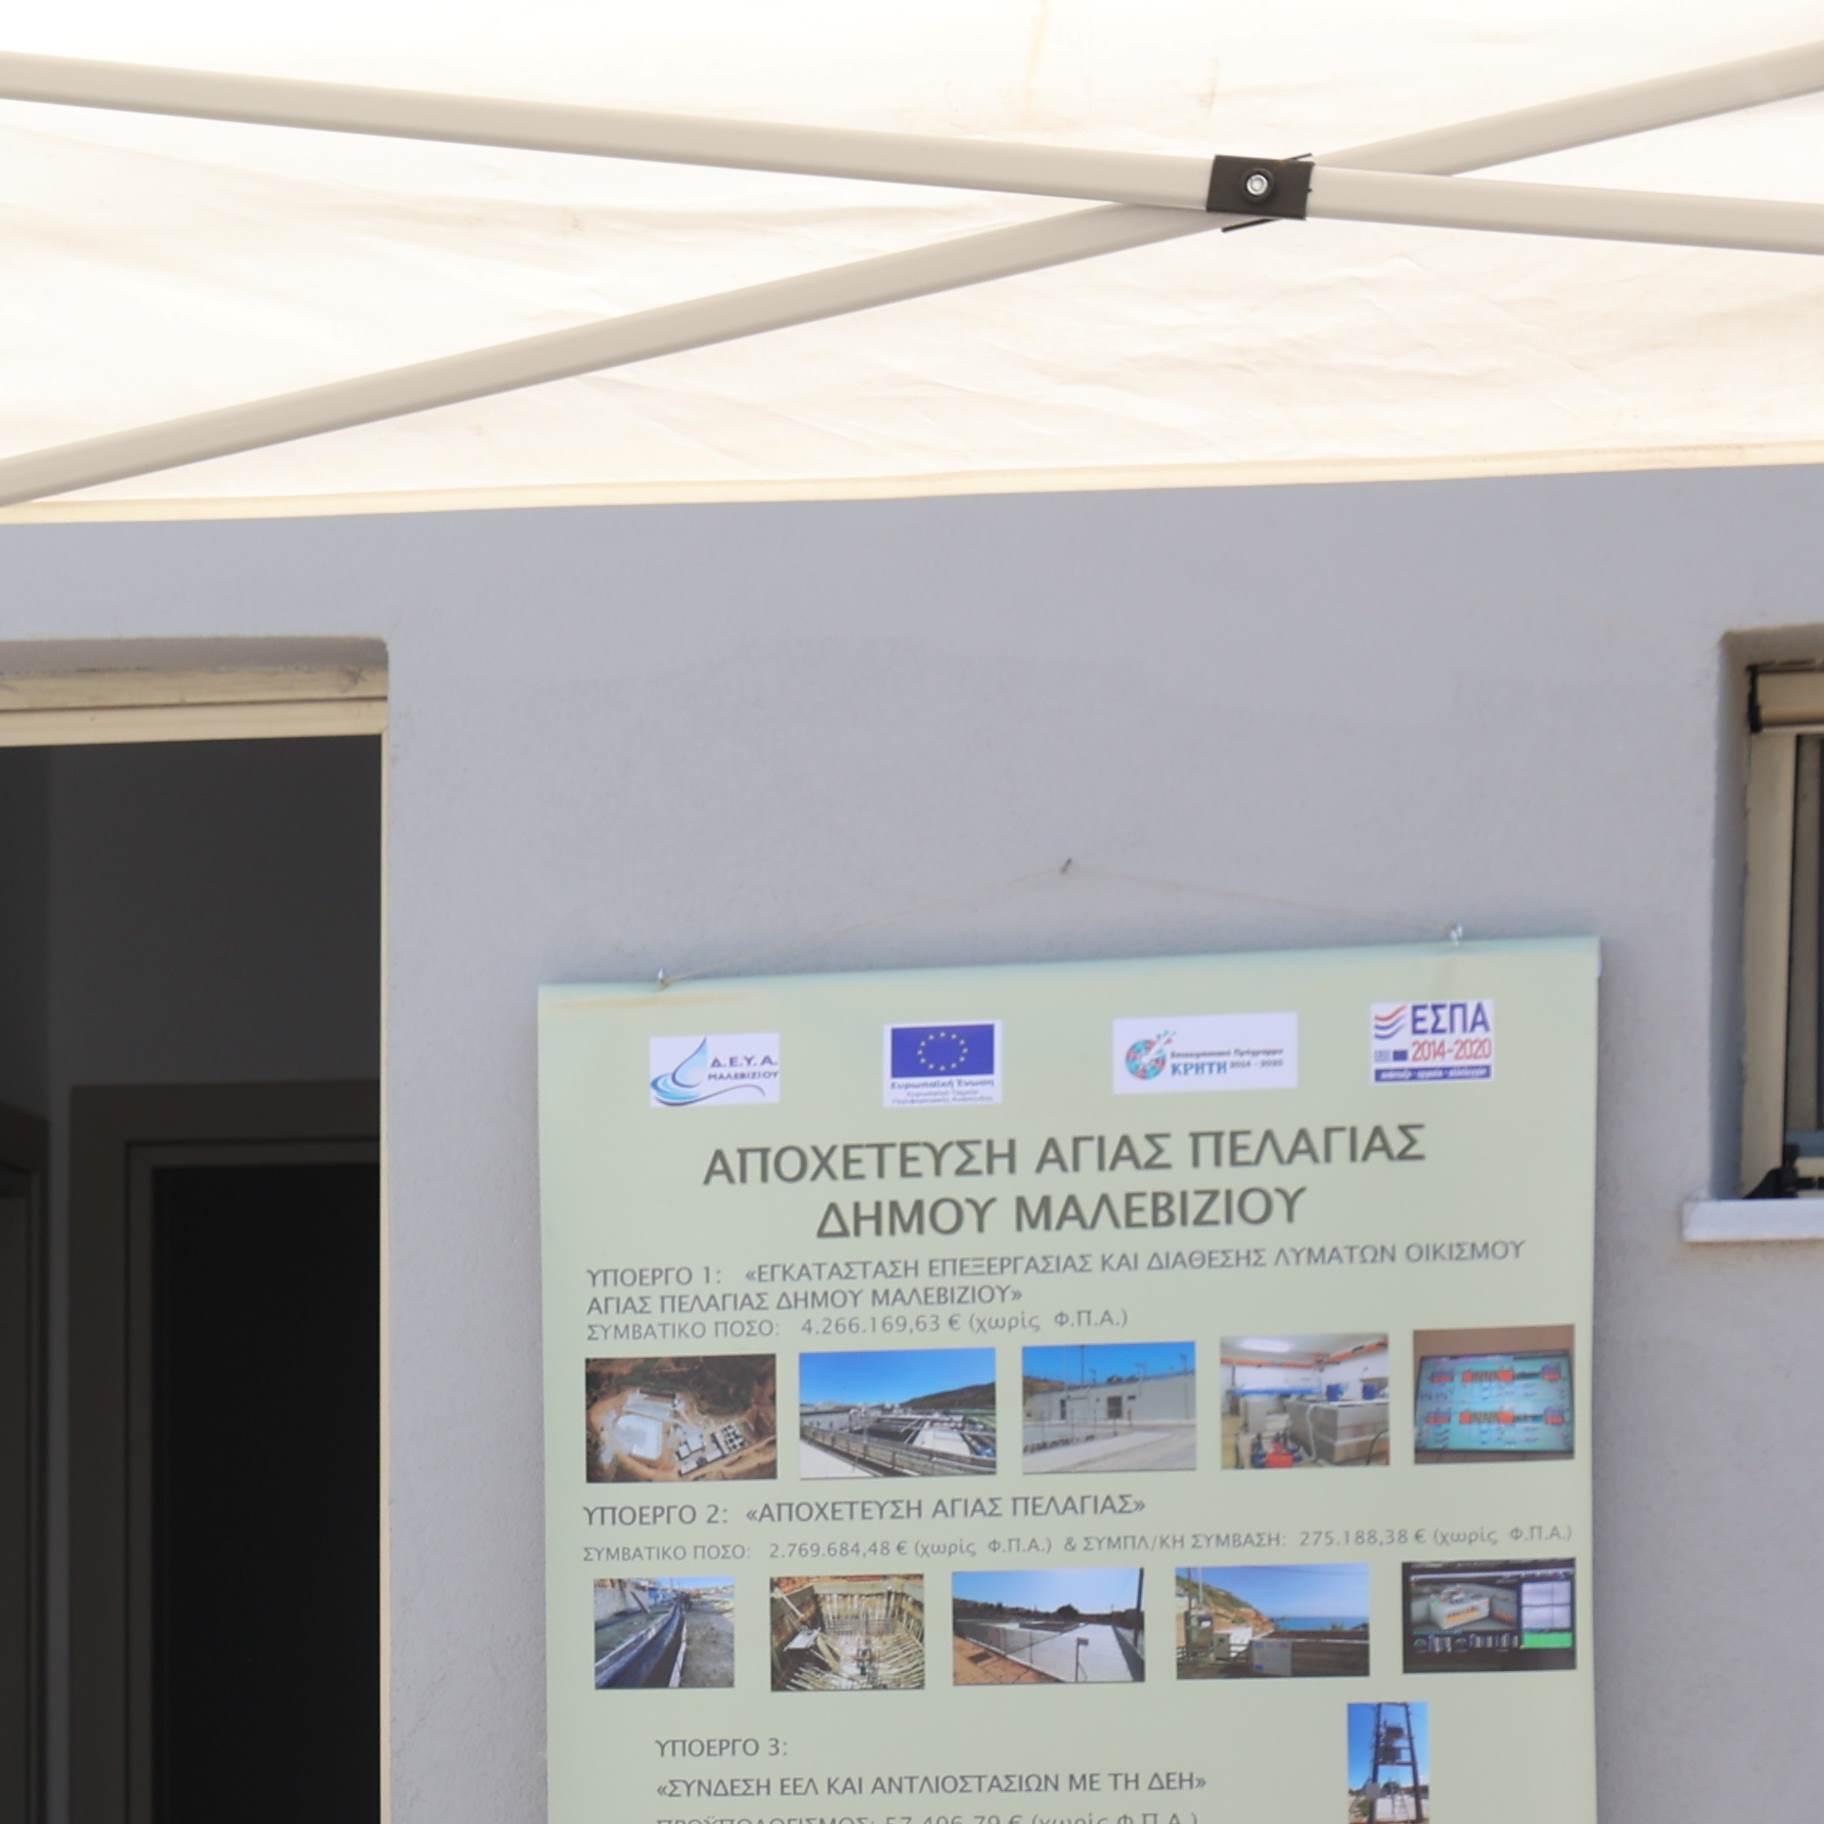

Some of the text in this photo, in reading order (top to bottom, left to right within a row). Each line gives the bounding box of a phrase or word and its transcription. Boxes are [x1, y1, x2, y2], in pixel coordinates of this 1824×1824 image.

[1412, 1002, 1489, 1034] ΕΣΠΑ
[1412, 1039, 1491, 1062] 2014-2020
[1172, 1061, 1227, 1077] ΚΡΗΤΗ
[703, 1124, 1425, 1186] ΑΠΟΧΕΤΕΥΣΗ ΑΓΙΑΣ ΠΕΛΑΓΙΑΣ
[816, 1186, 1306, 1238] ΔΗΜΟΥ ΜΑΛΕΒΙΖΙΟΥ
[655, 1738, 786, 1757] ΥΠΟΕΡΓΟ 3:
[657, 1772, 1206, 1797] «ΣΥΝΔΕΣΗ ΕΕΛ ΚΑΙ ΑΝΤΛΙΟΣΤΑΣΙΩΝ ΜΕ ΤΗ ΔΕΗ»
